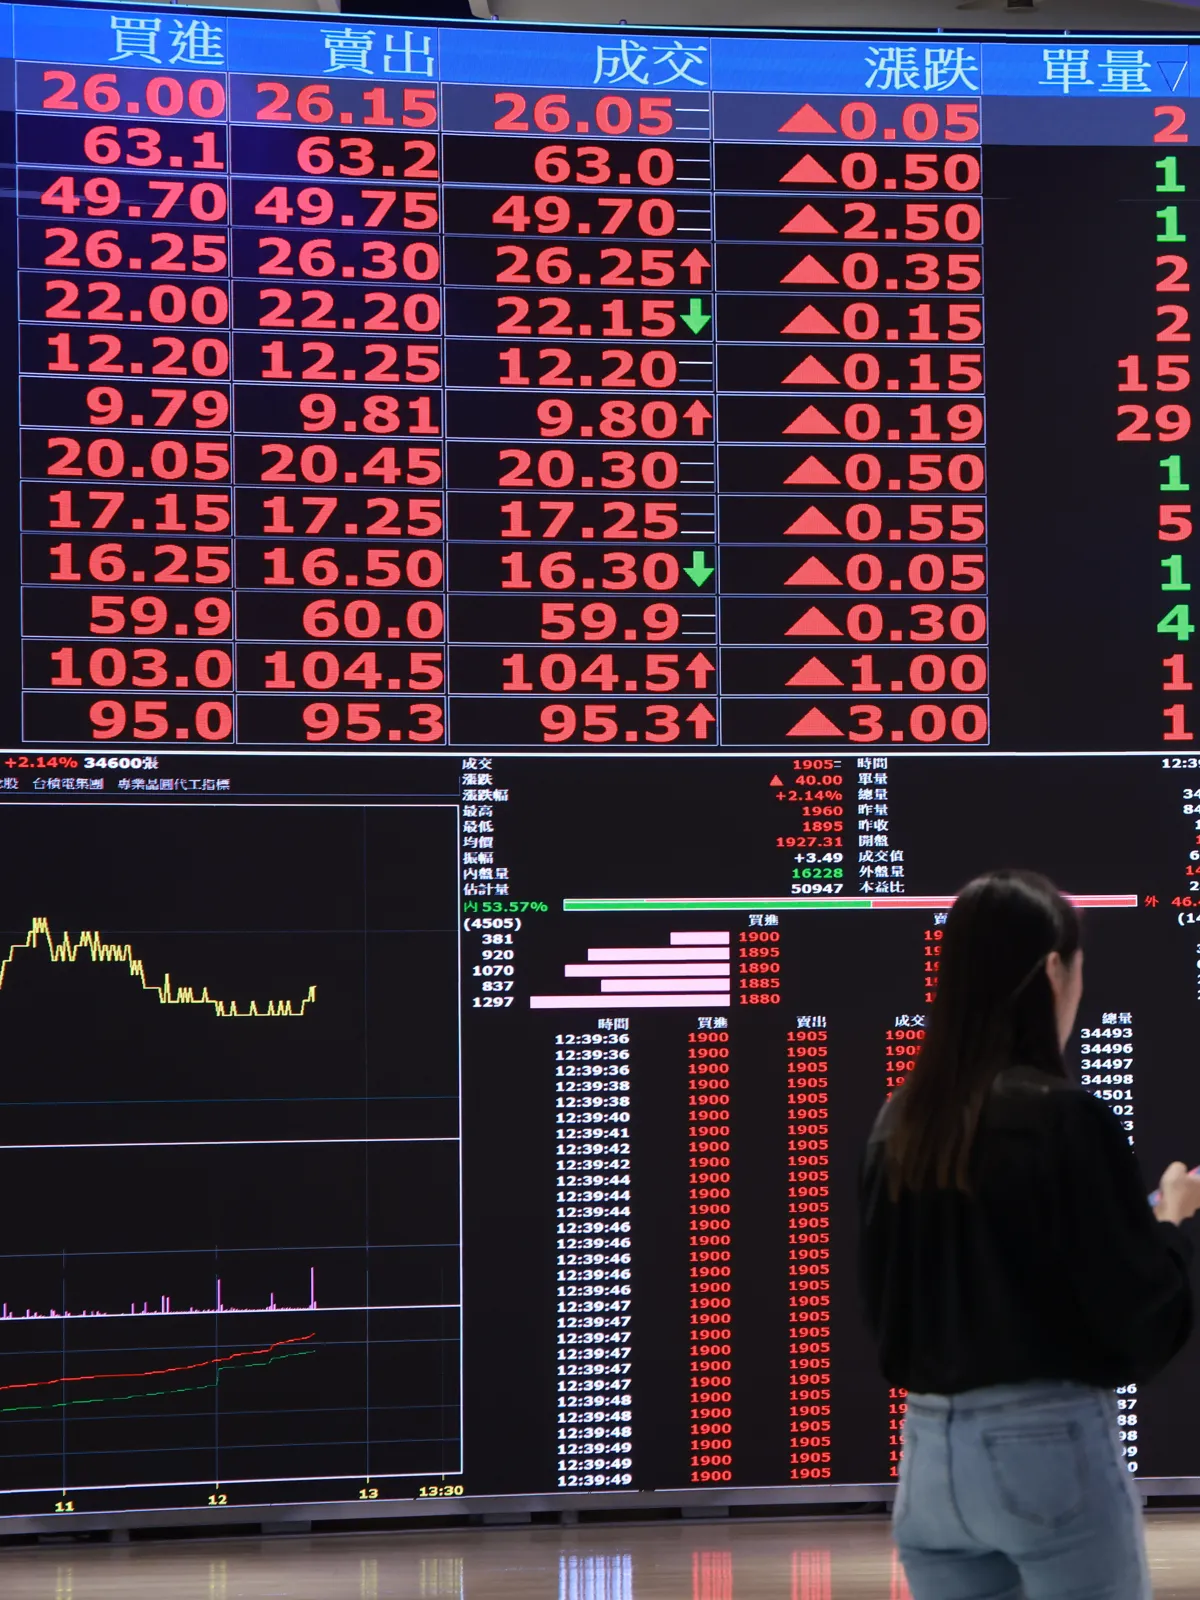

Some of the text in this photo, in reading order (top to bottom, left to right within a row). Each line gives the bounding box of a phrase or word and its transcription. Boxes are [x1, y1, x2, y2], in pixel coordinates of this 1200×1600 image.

[107, 12, 1151, 92] 買進 賣出 成交 漲跌 單量
[43, 71, 1188, 142] 26.00 26.15 26.05 0.05 2
[45, 228, 1190, 292] 26.25 26.30 26.25 0.35 2
[87, 387, 1191, 441] 9.79 9.81 9.80 0.19 29
[50, 543, 1191, 591] 16.25 16.50 16.30 0.05 1
[90, 700, 1193, 742] 95.0 95.3 95.3 3.00 1
[4, 756, 79, 769] +2.14%
[462, 759, 834, 770] 成交 1905
[856, 756, 888, 770] 時間
[461, 772, 843, 786] 漲跌 40.00
[857, 772, 888, 786] 單量
[461, 788, 843, 802] 漲跌幅 +2.14%
[857, 787, 889, 801] 總量
[462, 804, 844, 818] 最高 1960
[793, 852, 844, 864] +3.49
[858, 849, 905, 863] 成交值
[792, 867, 844, 879] 16228
[463, 882, 844, 896] 估計量 50947
[858, 880, 905, 894] 本益比
[482, 901, 549, 913] 53.57%
[1144, 895, 1159, 908] 外
[463, 913, 779, 932] (4505) 買進
[481, 931, 781, 945] 381 1900
[472, 962, 781, 977] 1070 1890
[597, 1011, 1133, 1031] 時間 買進 賣出 總量
[554, 1027, 1134, 1045] 12:39:36 1900 1905 34493
[556, 1139, 829, 1156] 12:39:42 1900 1905
[557, 1467, 831, 1487] 12:39:49 1900 1905
[55, 1485, 464, 1513] 11 12 13 13:30
